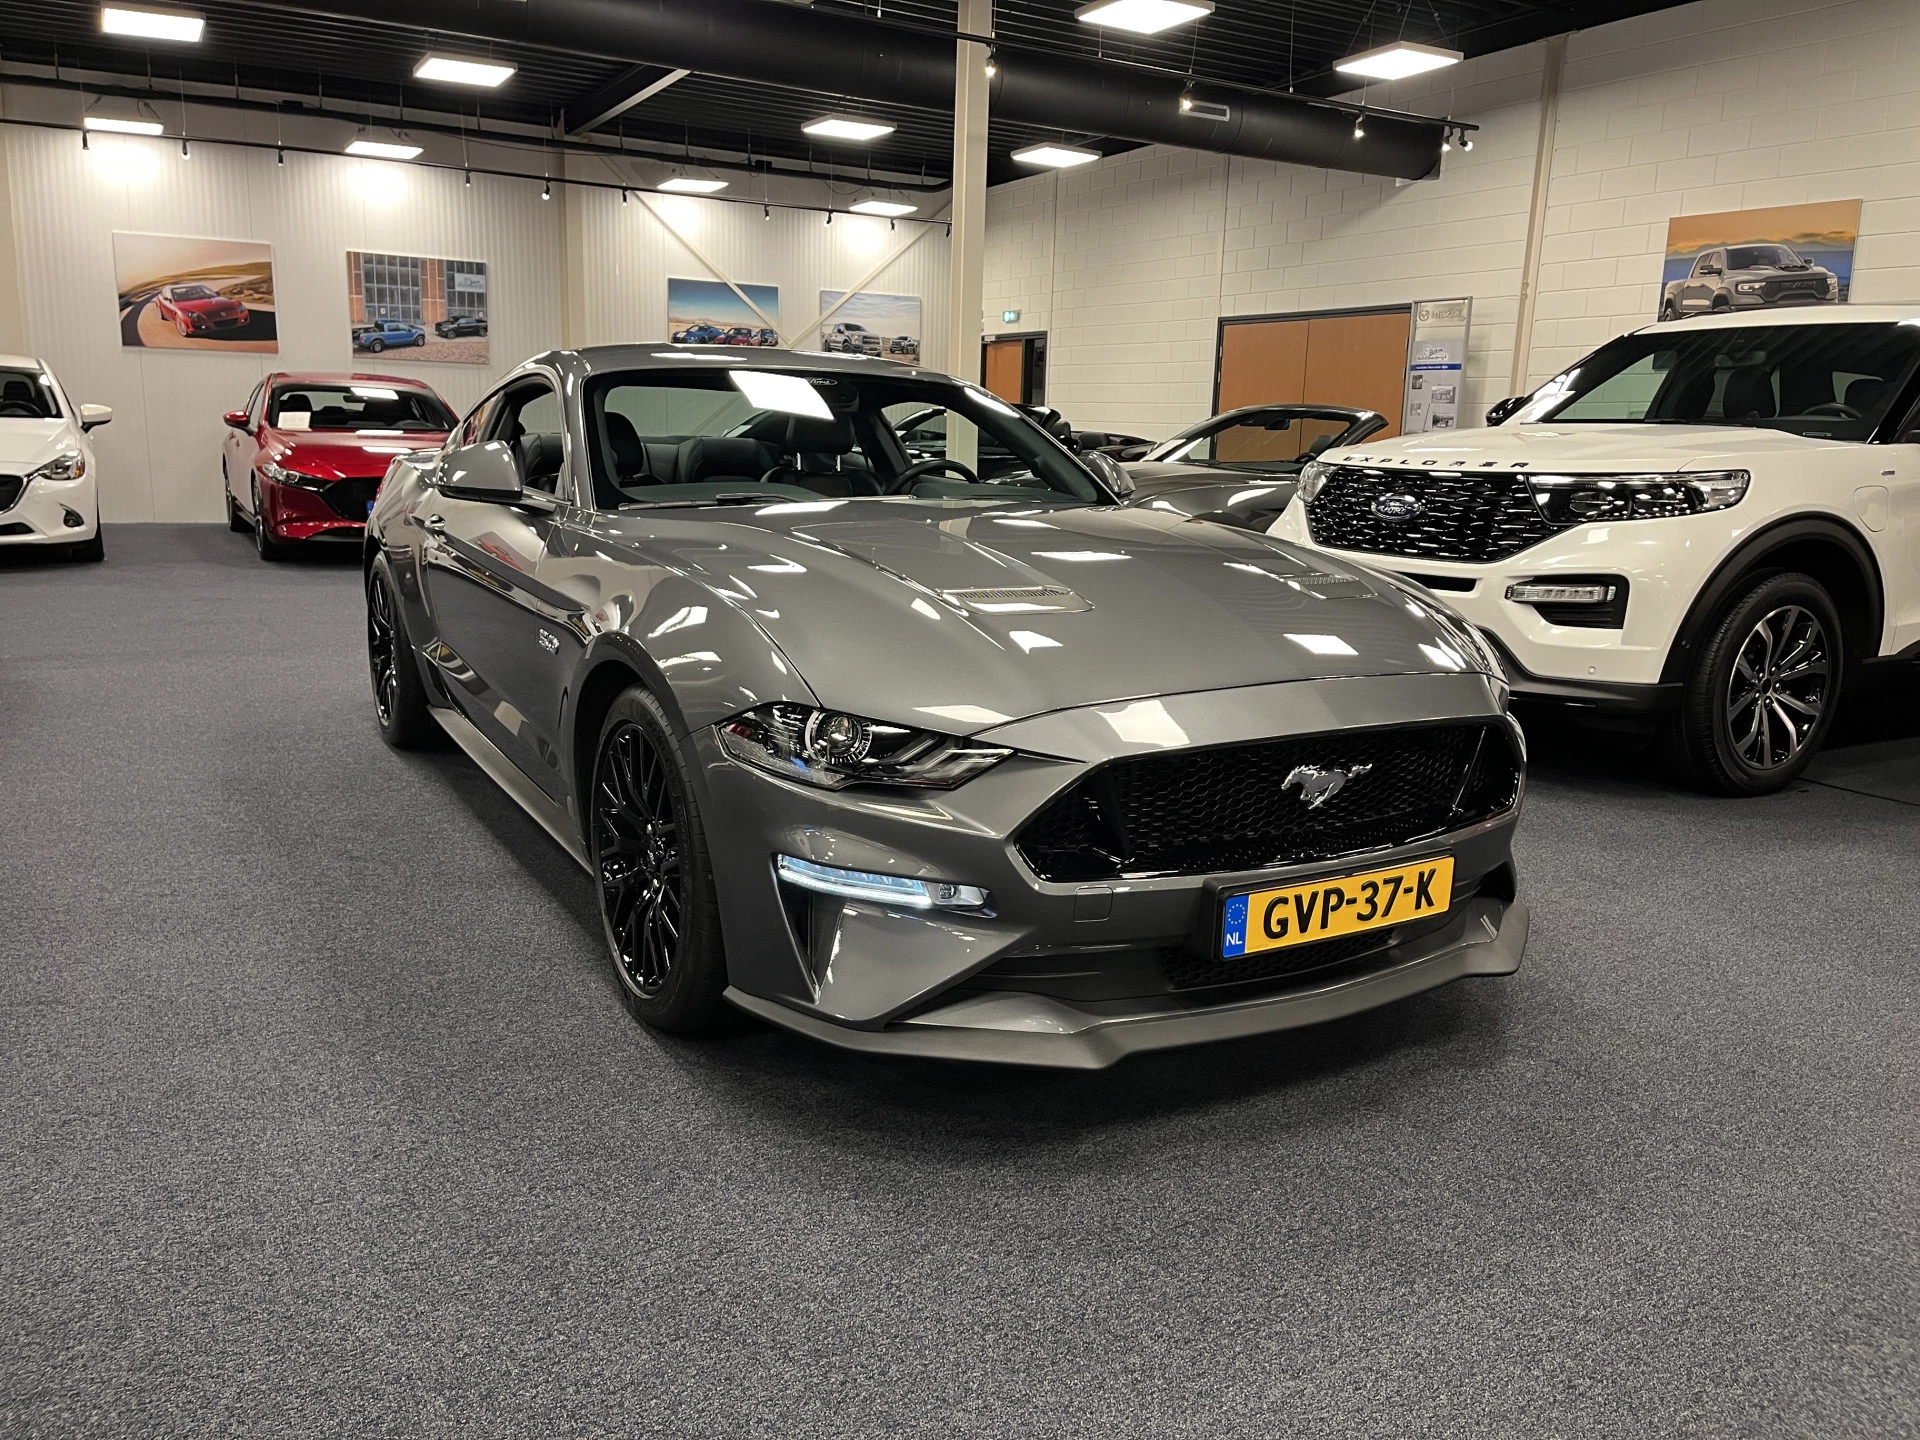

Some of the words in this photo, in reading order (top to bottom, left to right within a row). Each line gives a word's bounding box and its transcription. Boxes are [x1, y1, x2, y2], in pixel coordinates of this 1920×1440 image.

[1343, 455, 1530, 469] EXPLORER
[1263, 868, 1437, 940] GVP-37-K
[1226, 931, 1243, 947] NL
